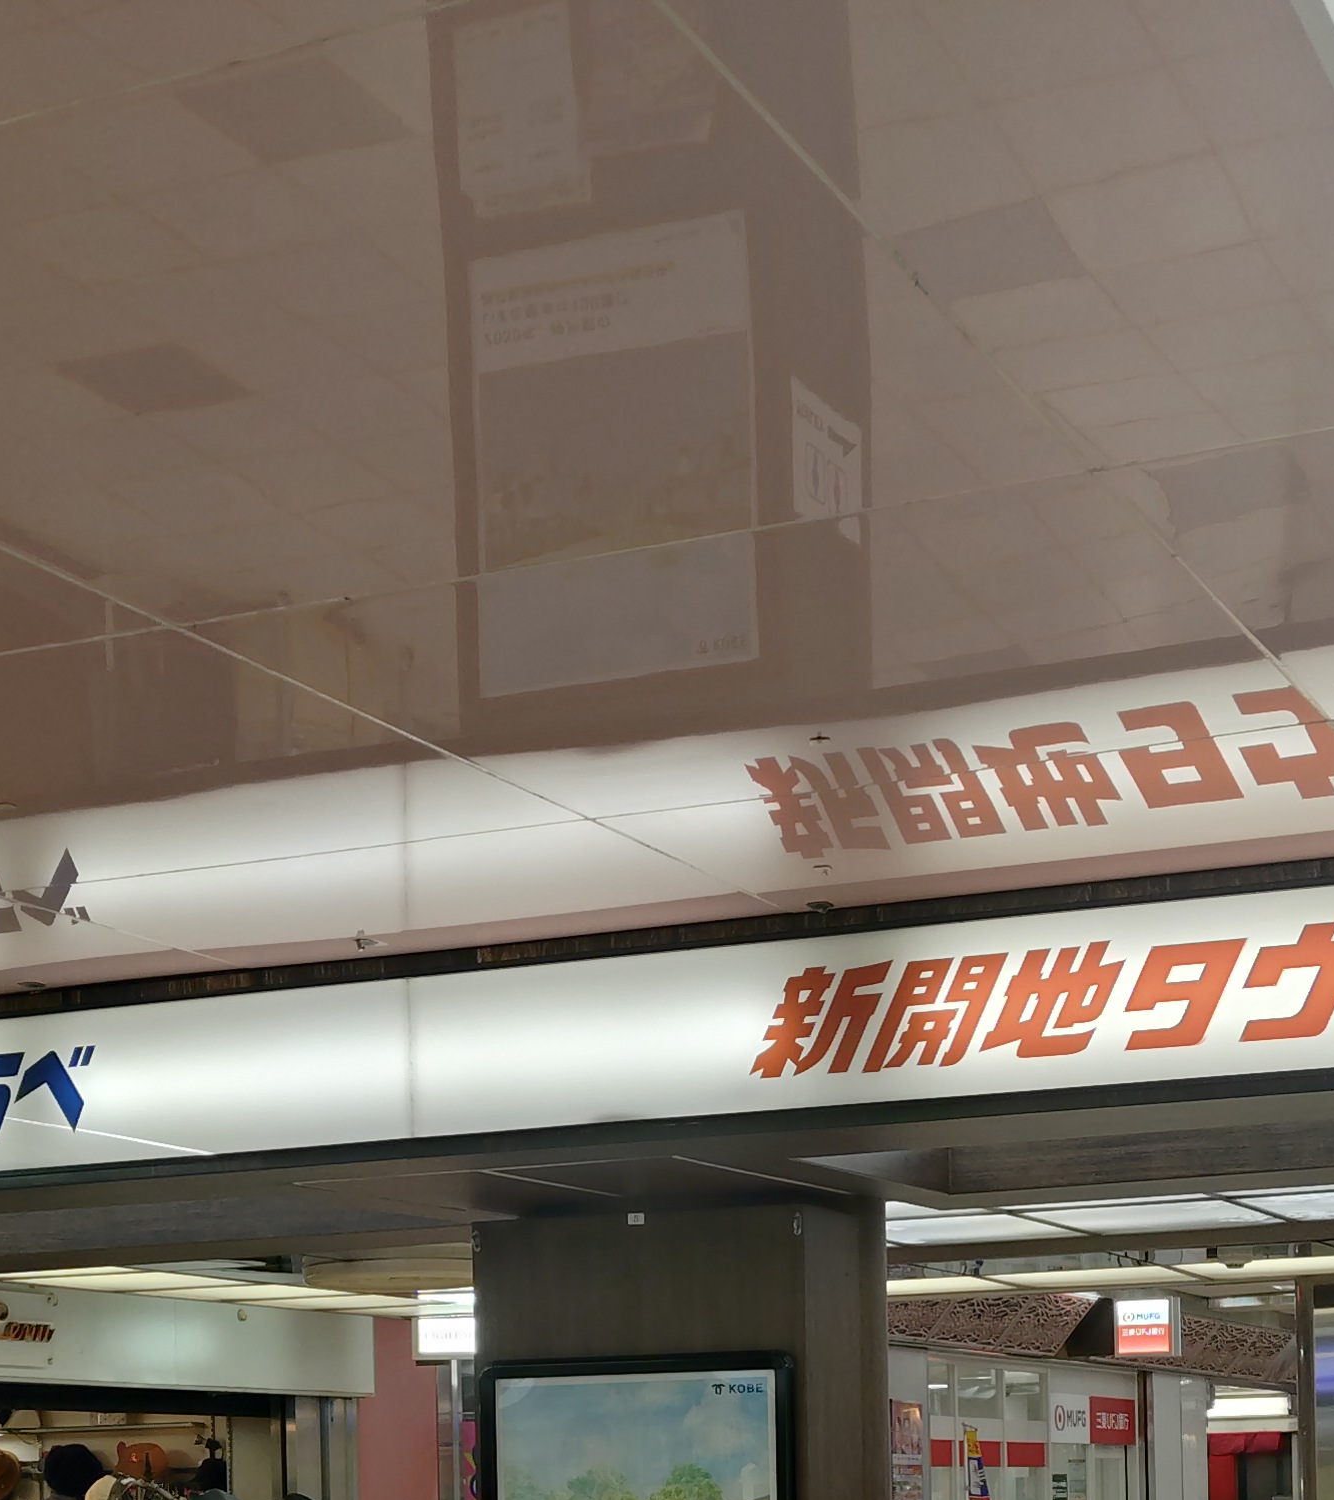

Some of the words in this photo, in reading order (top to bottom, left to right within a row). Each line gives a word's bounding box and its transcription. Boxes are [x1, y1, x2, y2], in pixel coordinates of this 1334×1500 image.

[1136, 1312, 1161, 1320] MUFG
[729, 1383, 764, 1394] KOBE
[1066, 1409, 1087, 1428] MUFG
